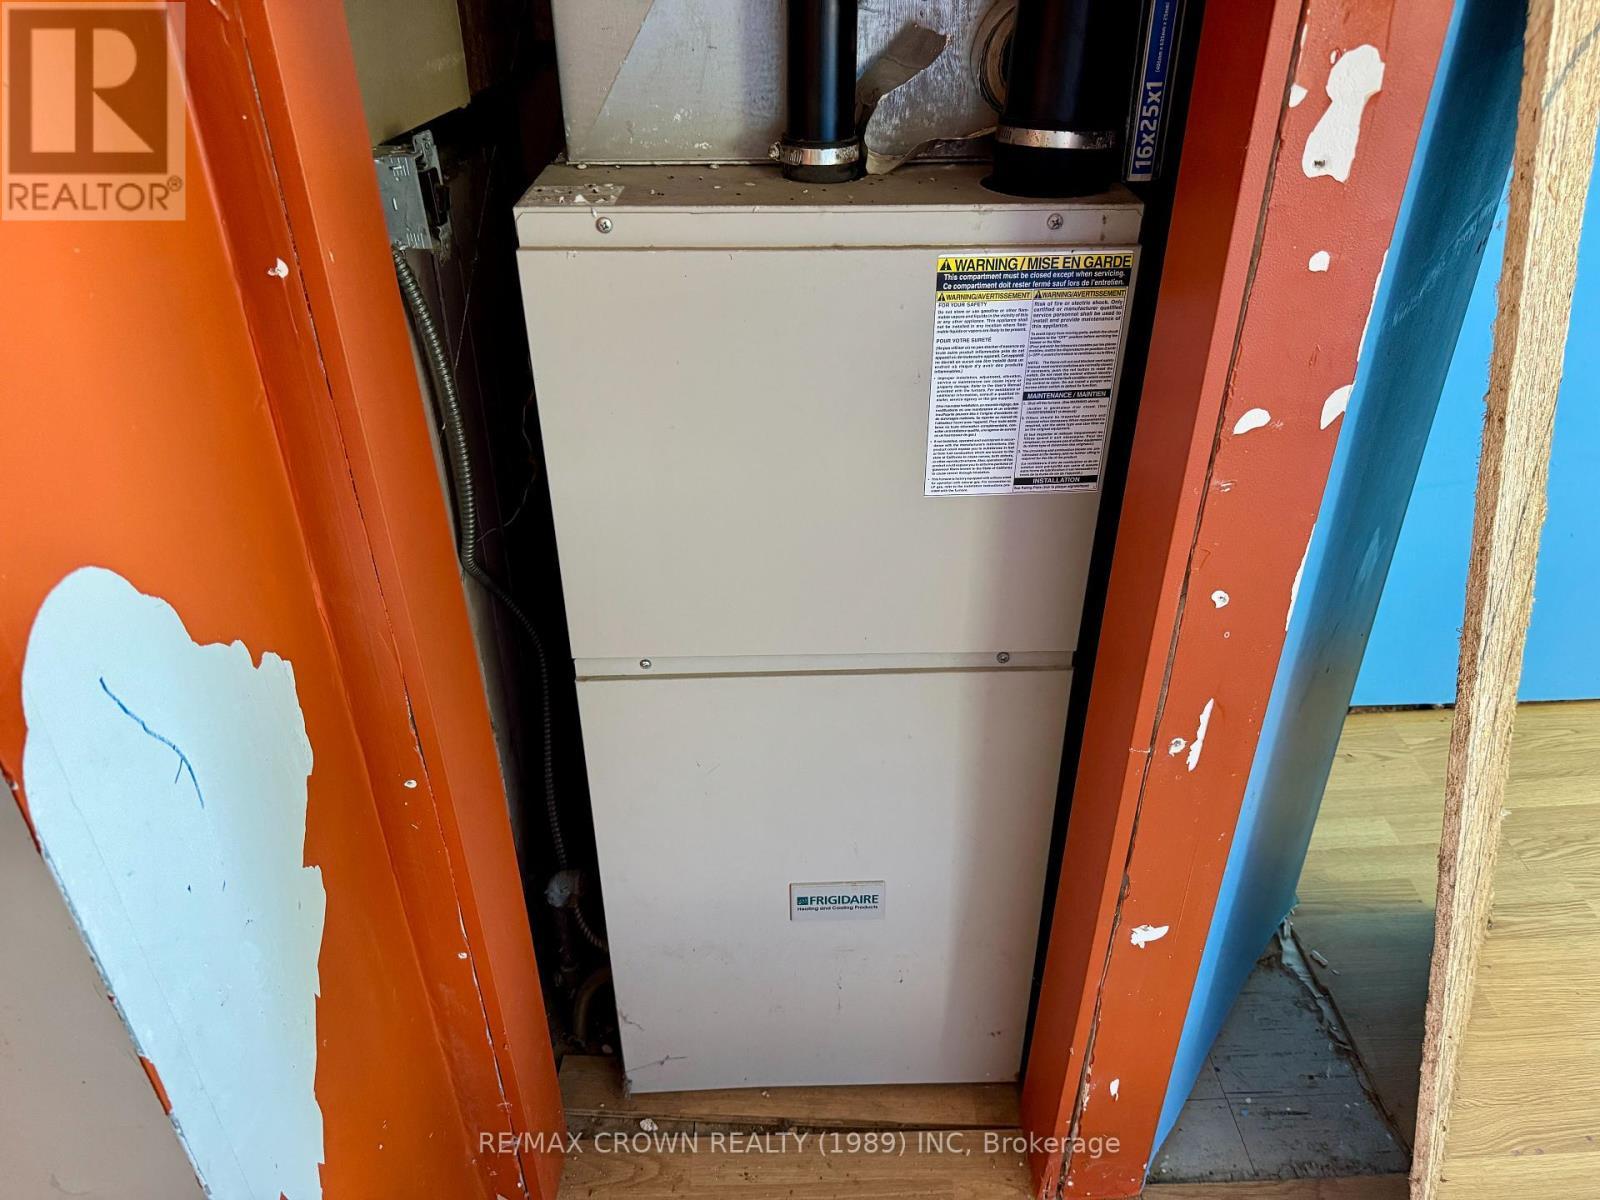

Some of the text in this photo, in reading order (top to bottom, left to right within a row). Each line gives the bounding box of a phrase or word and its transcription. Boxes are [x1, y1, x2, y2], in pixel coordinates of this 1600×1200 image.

[1135, 81, 1163, 169] 16x25x1
[955, 255, 1132, 271] WARNING / MISE EN GARDE
[958, 273, 1002, 281] compartment
[1053, 271, 1074, 280] except
[1094, 270, 1126, 279] servicing.
[954, 282, 998, 290] compartiment
[1090, 278, 1124, 286] l'entretien.
[946, 292, 1030, 300] WARNING/AVERTISSEMENT
[1041, 290, 1126, 298] WARNING/AVERTISSEMENT
[810, 894, 879, 905] FRIGIDAIRE
